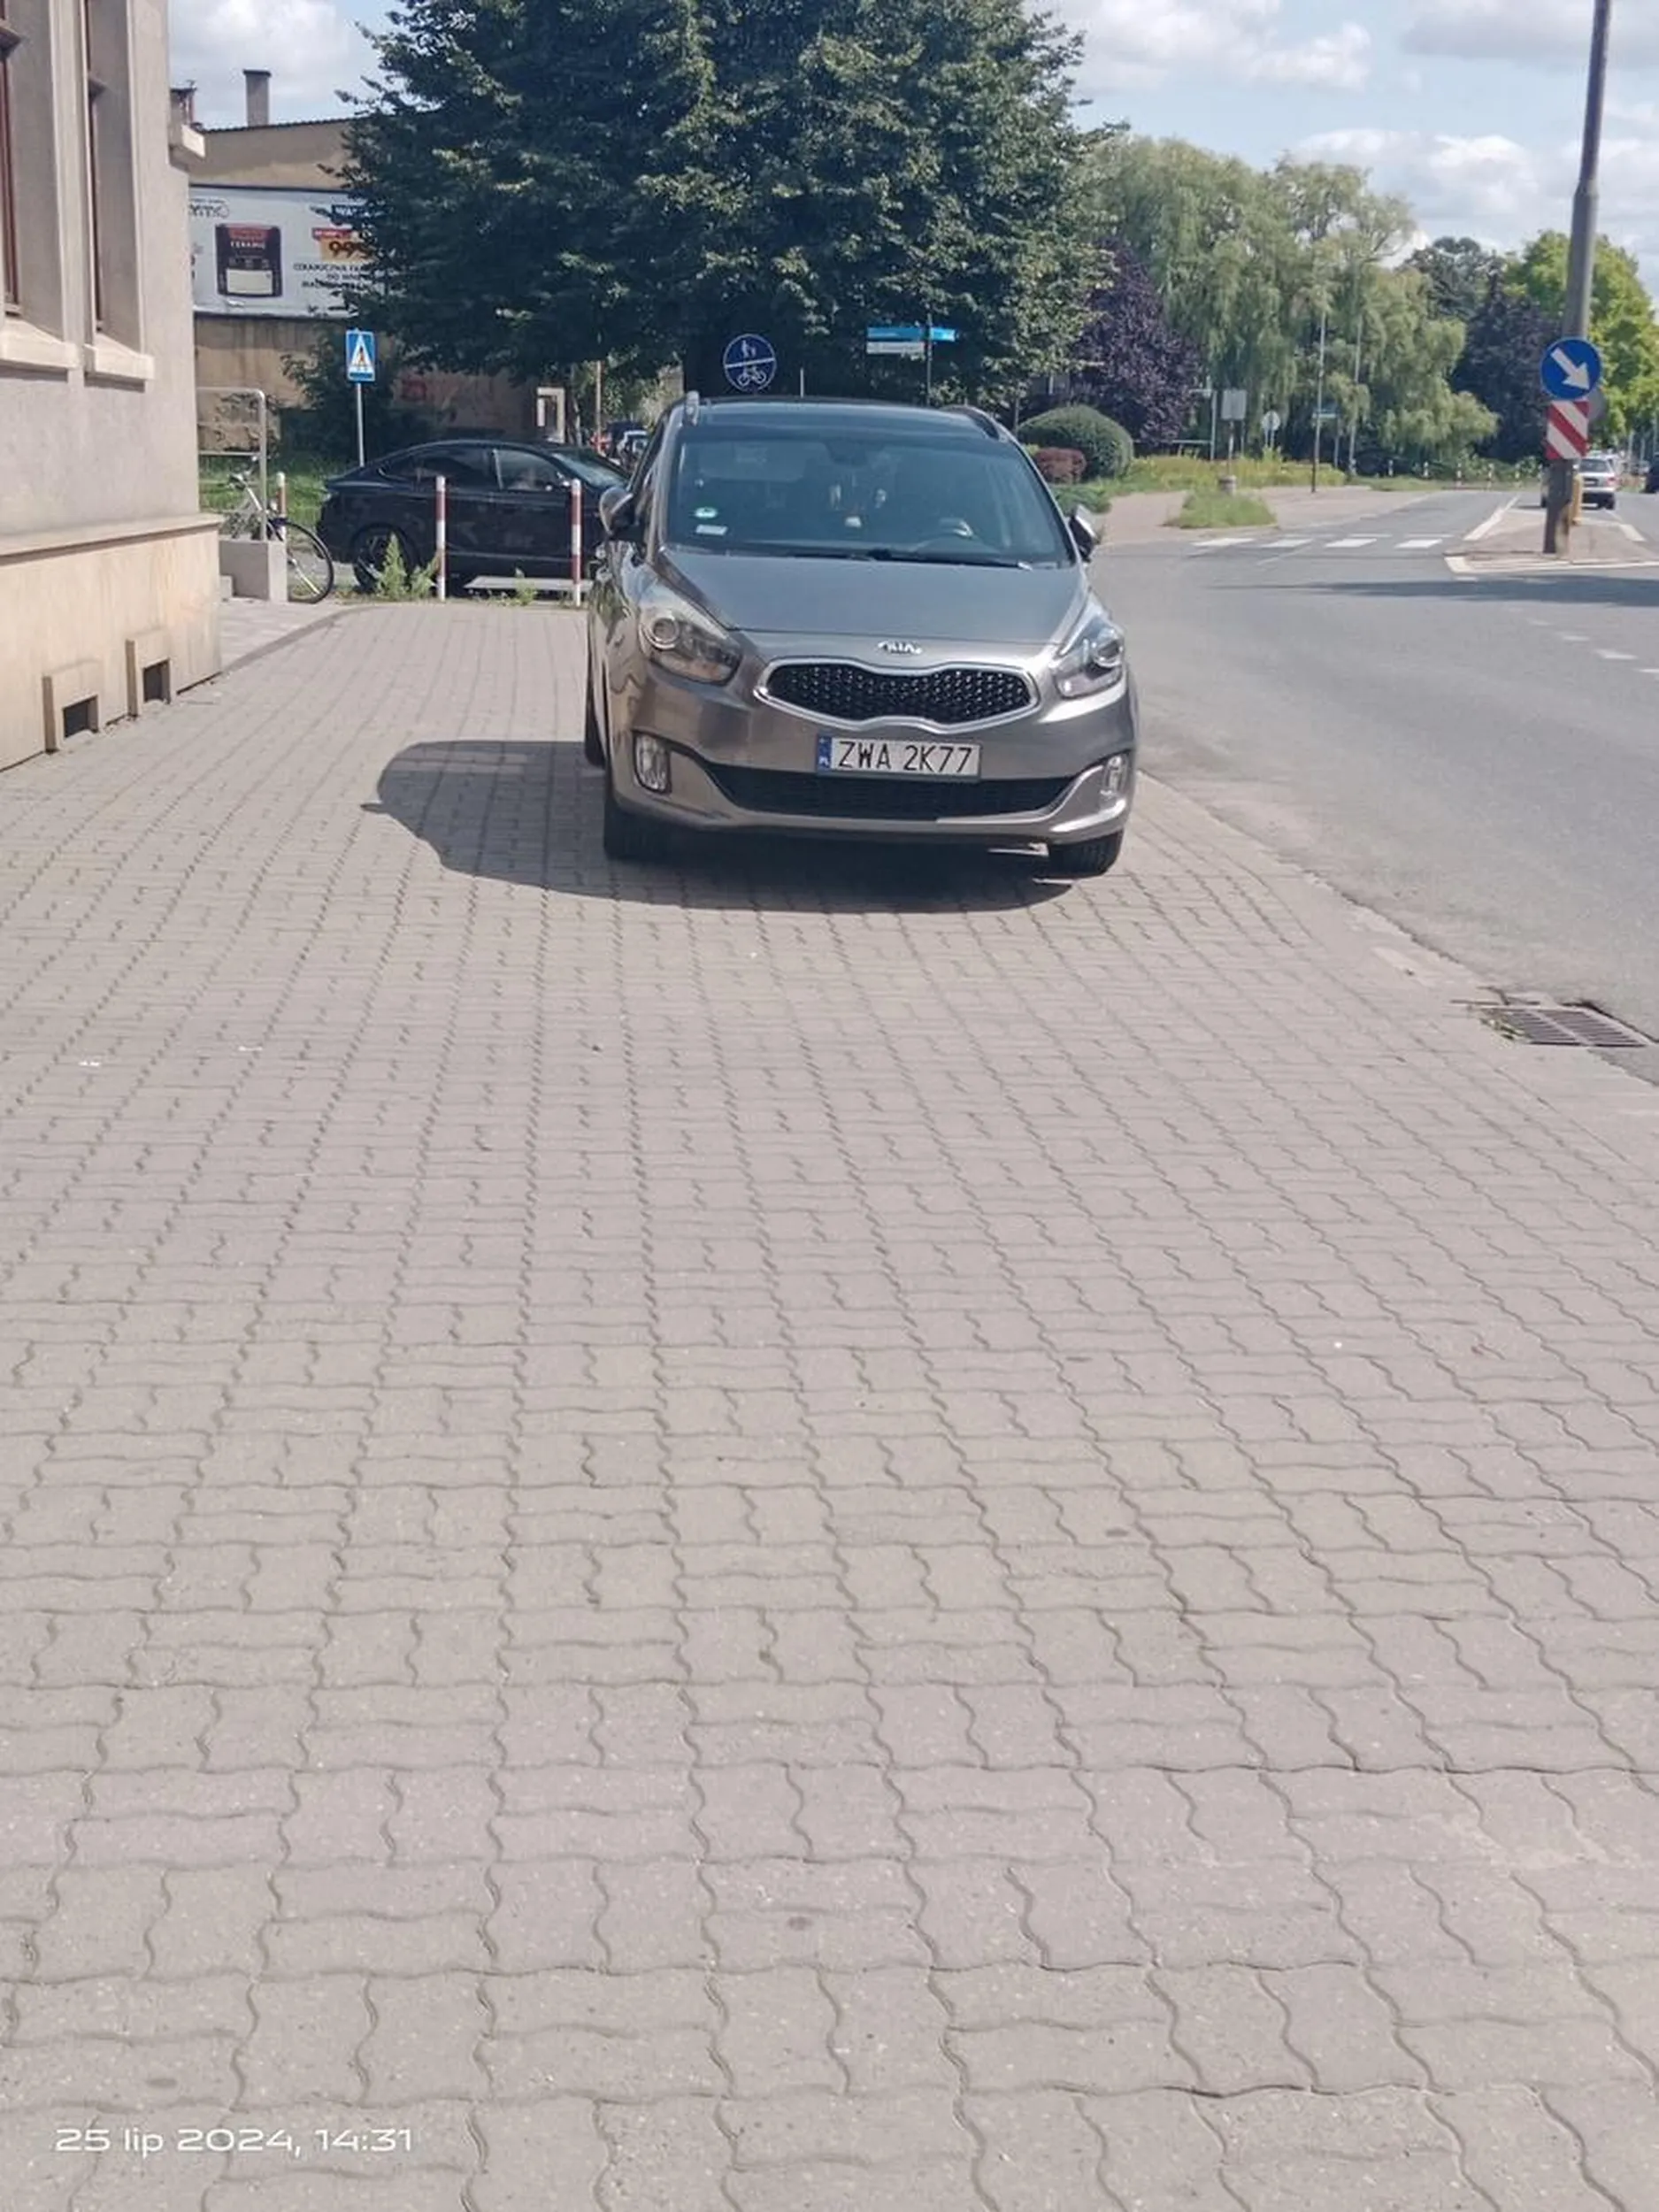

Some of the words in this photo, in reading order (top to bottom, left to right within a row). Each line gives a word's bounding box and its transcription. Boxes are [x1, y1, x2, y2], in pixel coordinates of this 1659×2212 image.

[885, 641, 915, 655] KIA
[838, 741, 892, 770] ZWA
[902, 744, 972, 773] 2K77
